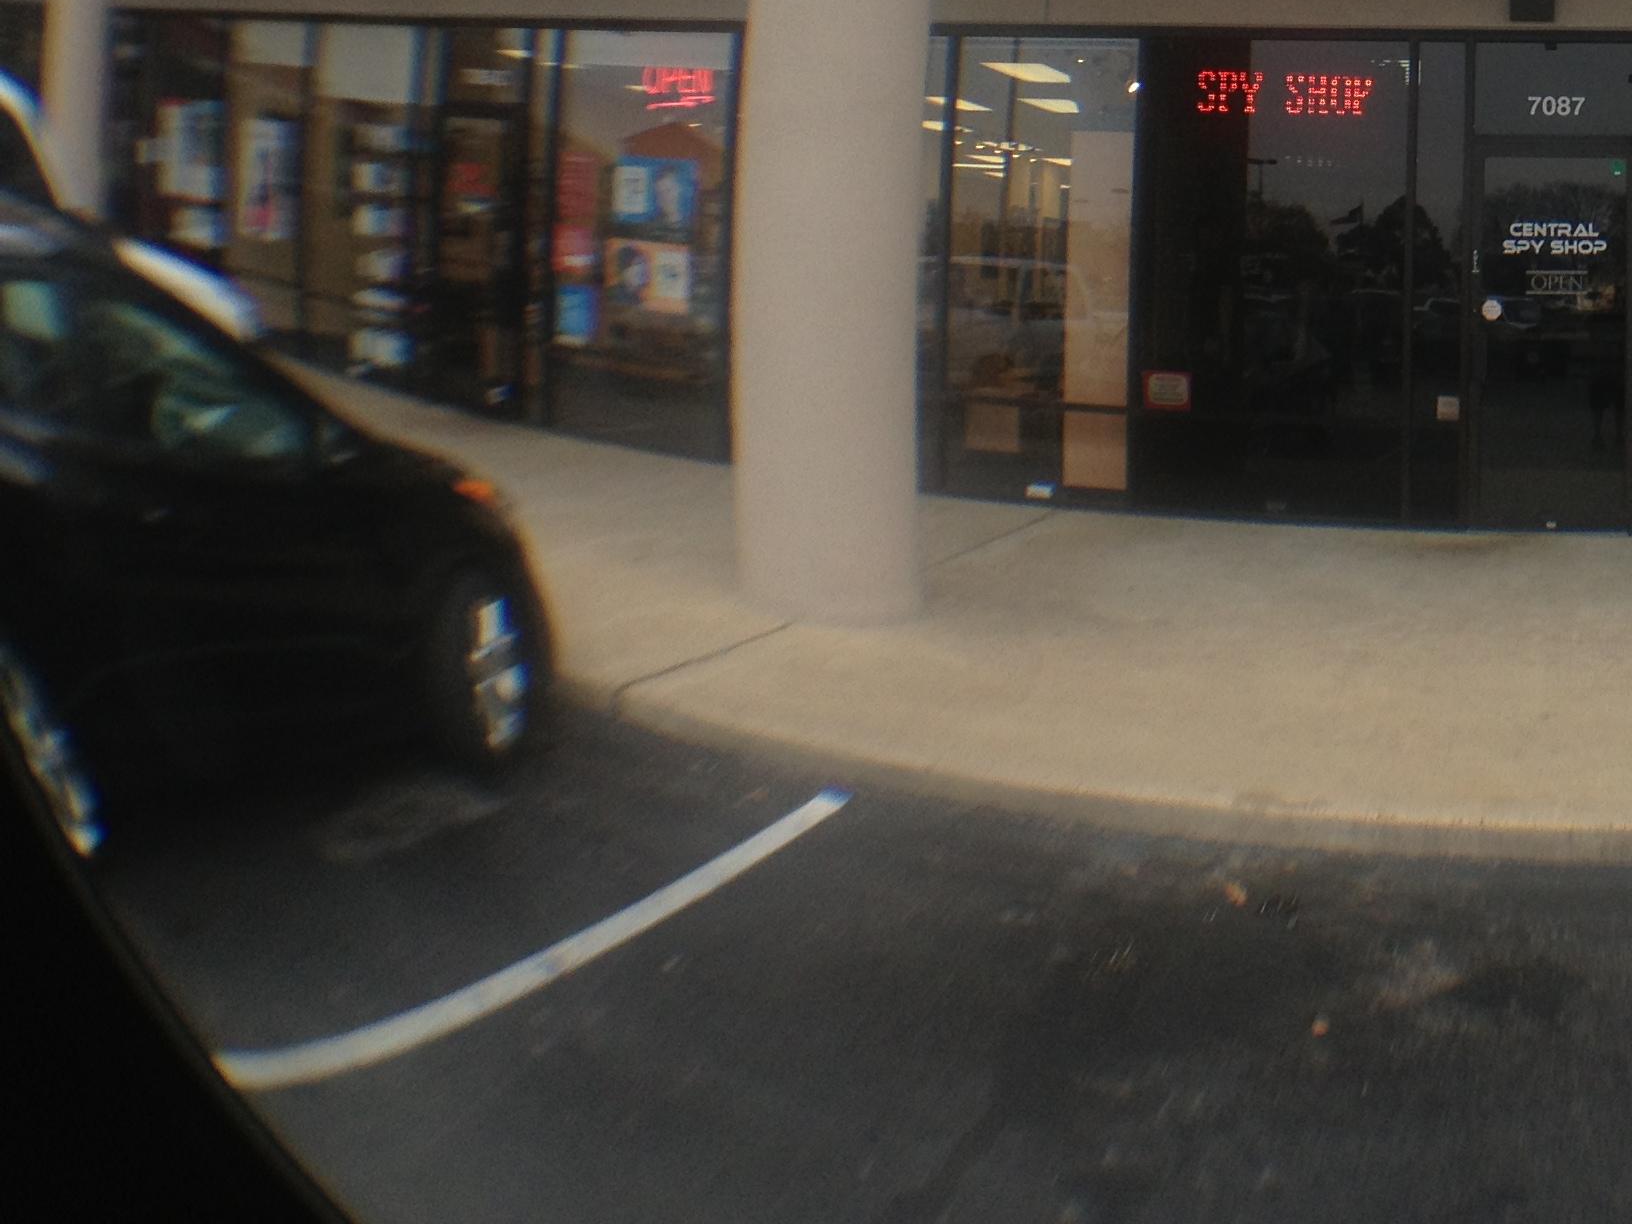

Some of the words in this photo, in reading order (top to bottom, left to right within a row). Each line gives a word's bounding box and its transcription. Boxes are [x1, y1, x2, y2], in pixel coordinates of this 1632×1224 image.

[642, 66, 715, 94] OPEN
[1197, 70, 1264, 114] SPY
[1285, 73, 1374, 116] SHOP
[1528, 96, 1586, 116] 7087
[1509, 222, 1600, 238] CENTRAL
[1502, 239, 1546, 255] SPY
[1550, 239, 1608, 255] SHOP
[1530, 275, 1583, 291] OPEN
